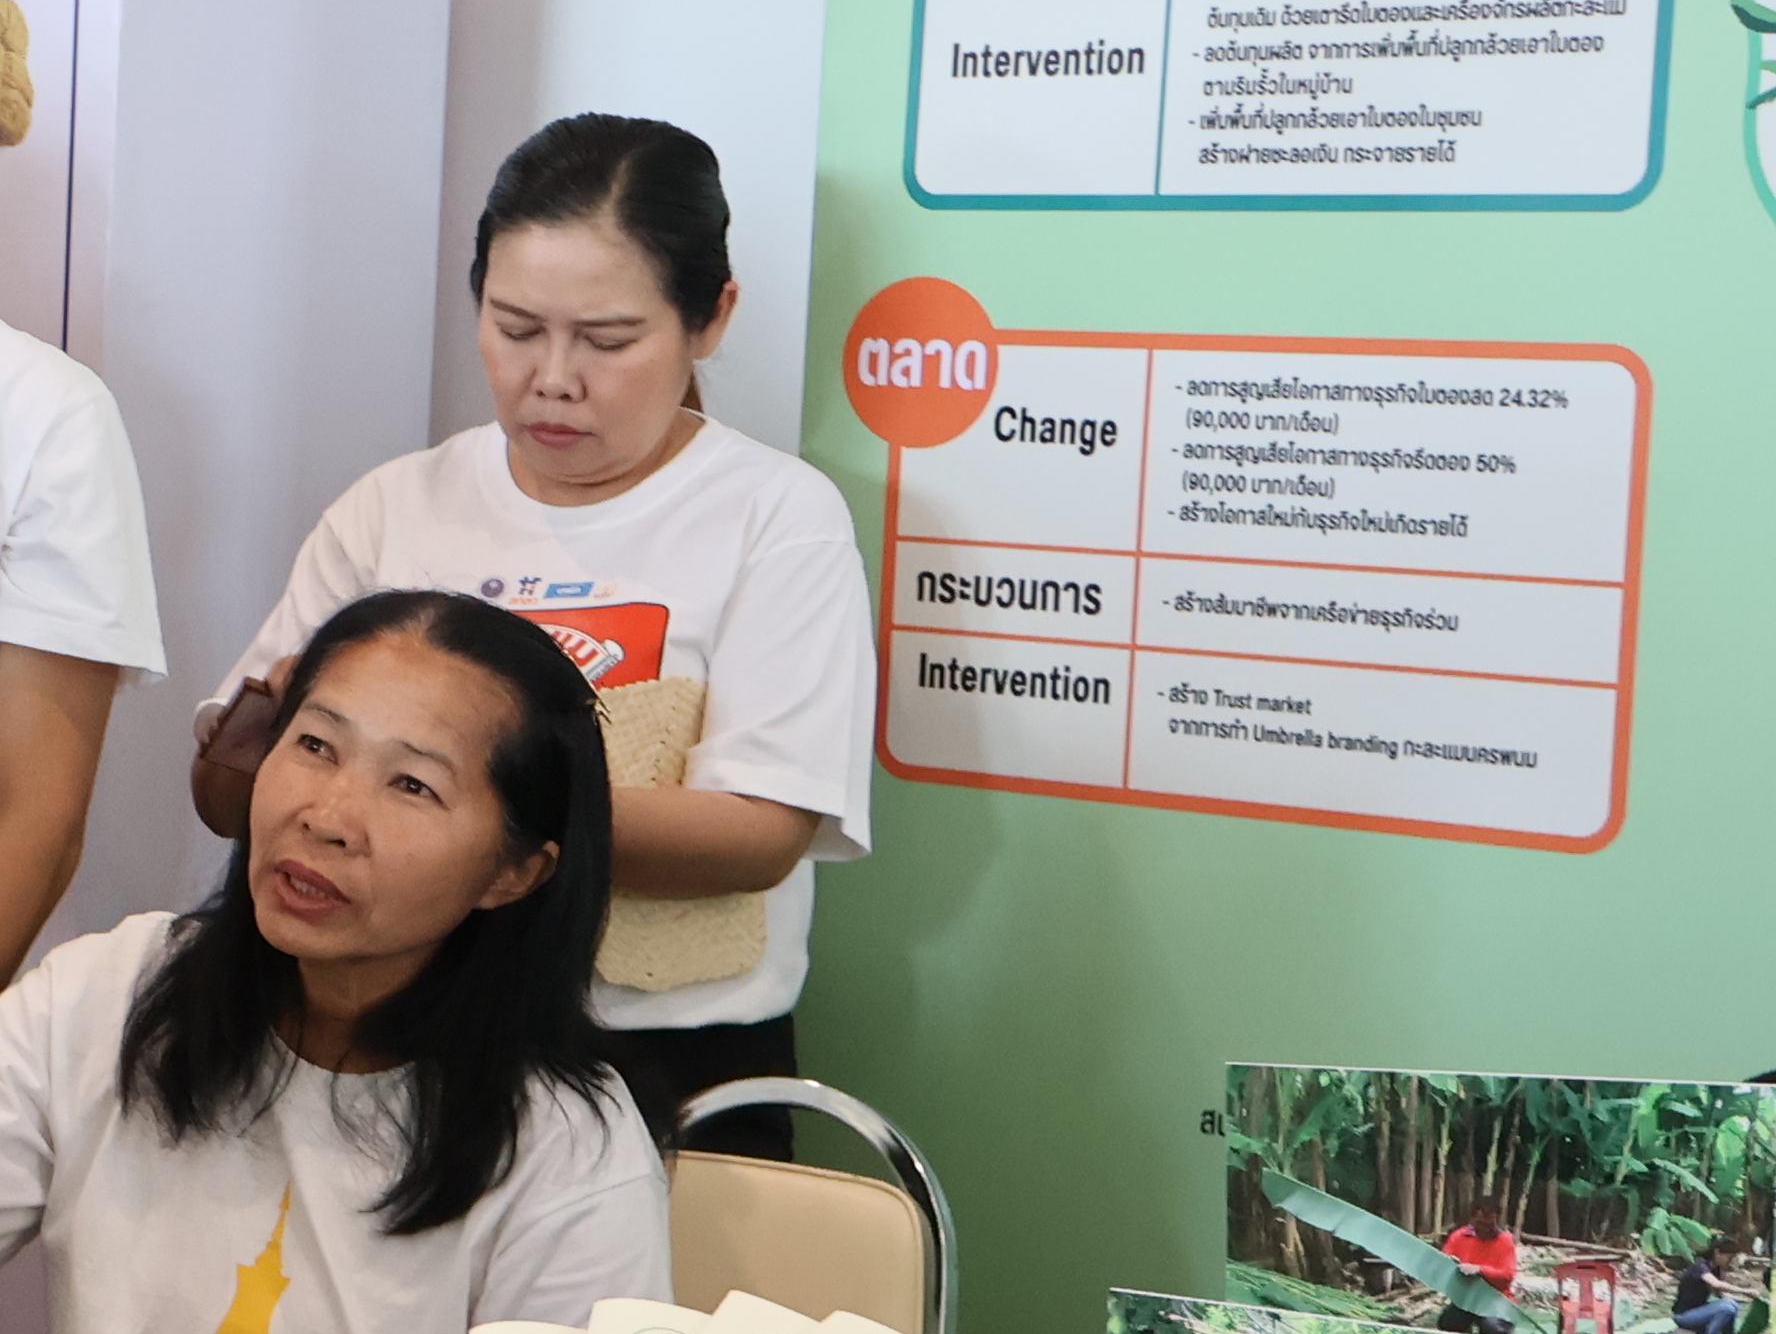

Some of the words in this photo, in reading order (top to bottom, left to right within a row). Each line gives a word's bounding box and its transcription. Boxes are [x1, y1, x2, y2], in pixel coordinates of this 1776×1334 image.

[951, 39, 1146, 78] Intervention
[857, 337, 989, 390] ตลาด
[1498, 387, 1569, 410] 24.32%
[994, 405, 1118, 457] Change
[1186, 408, 1250, 434] (90,000
[1255, 410, 1339, 436] บาท/เดือน)
[1475, 454, 1517, 474] 50%
[1182, 471, 1247, 495] (90,000
[1252, 474, 1336, 500] บาท/เดือน)
[916, 570, 1103, 616] กระบวนการ
[918, 651, 1112, 705] Intervention
[1168, 682, 1208, 705] สร้าง
[1214, 688, 1252, 710] Trust
[1256, 696, 1313, 715] market
[1253, 724, 1323, 748] Umbrella
[1327, 730, 1399, 761] branding
